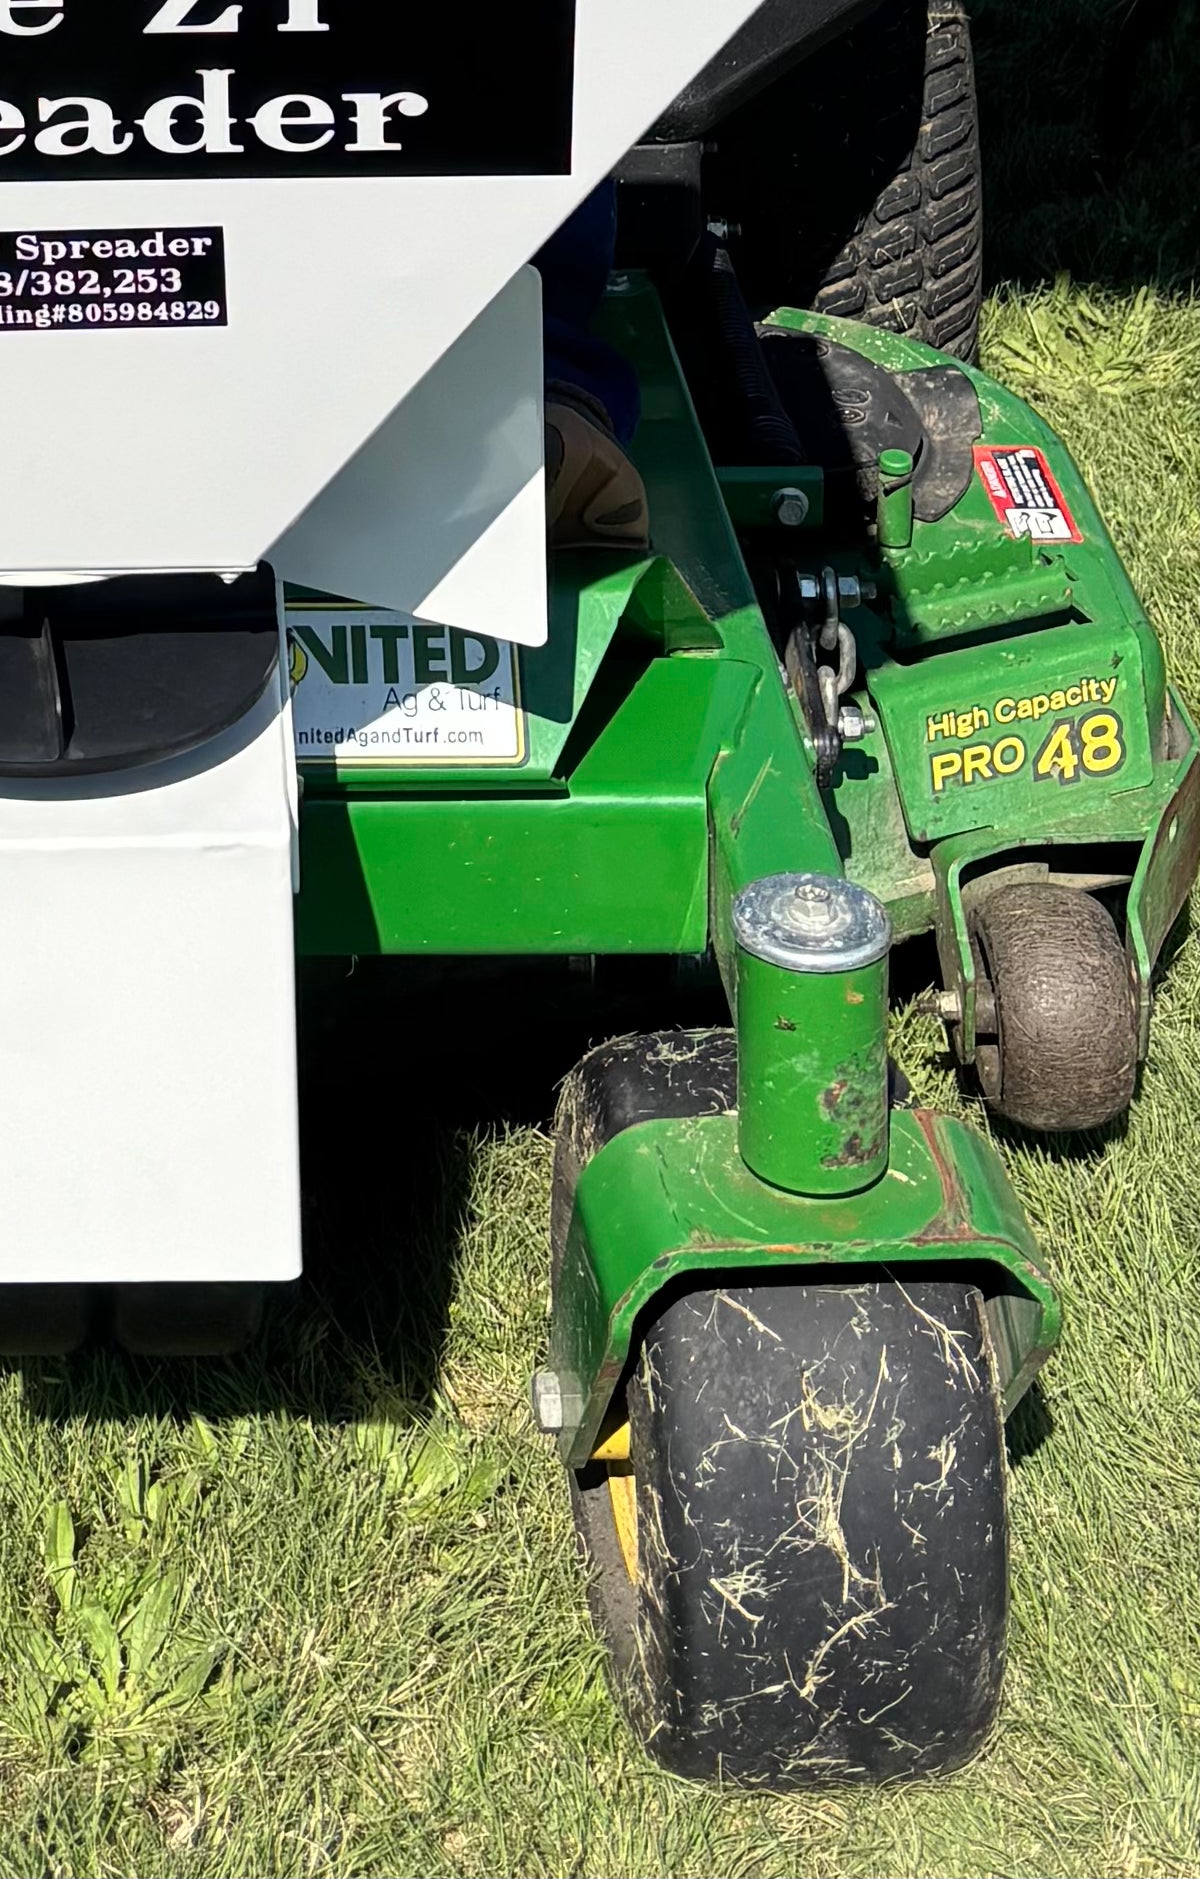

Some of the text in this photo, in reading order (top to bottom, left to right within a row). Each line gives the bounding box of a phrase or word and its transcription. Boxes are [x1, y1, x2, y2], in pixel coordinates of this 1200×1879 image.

[15, 231, 213, 266] Spreader
[287, 625, 500, 684] NITED
[383, 686, 500, 717] Ag & Turf
[927, 676, 1119, 742] High Capacity
[298, 726, 484, 747] nitedAgandTurf.com
[931, 713, 1123, 792] PRO 48
